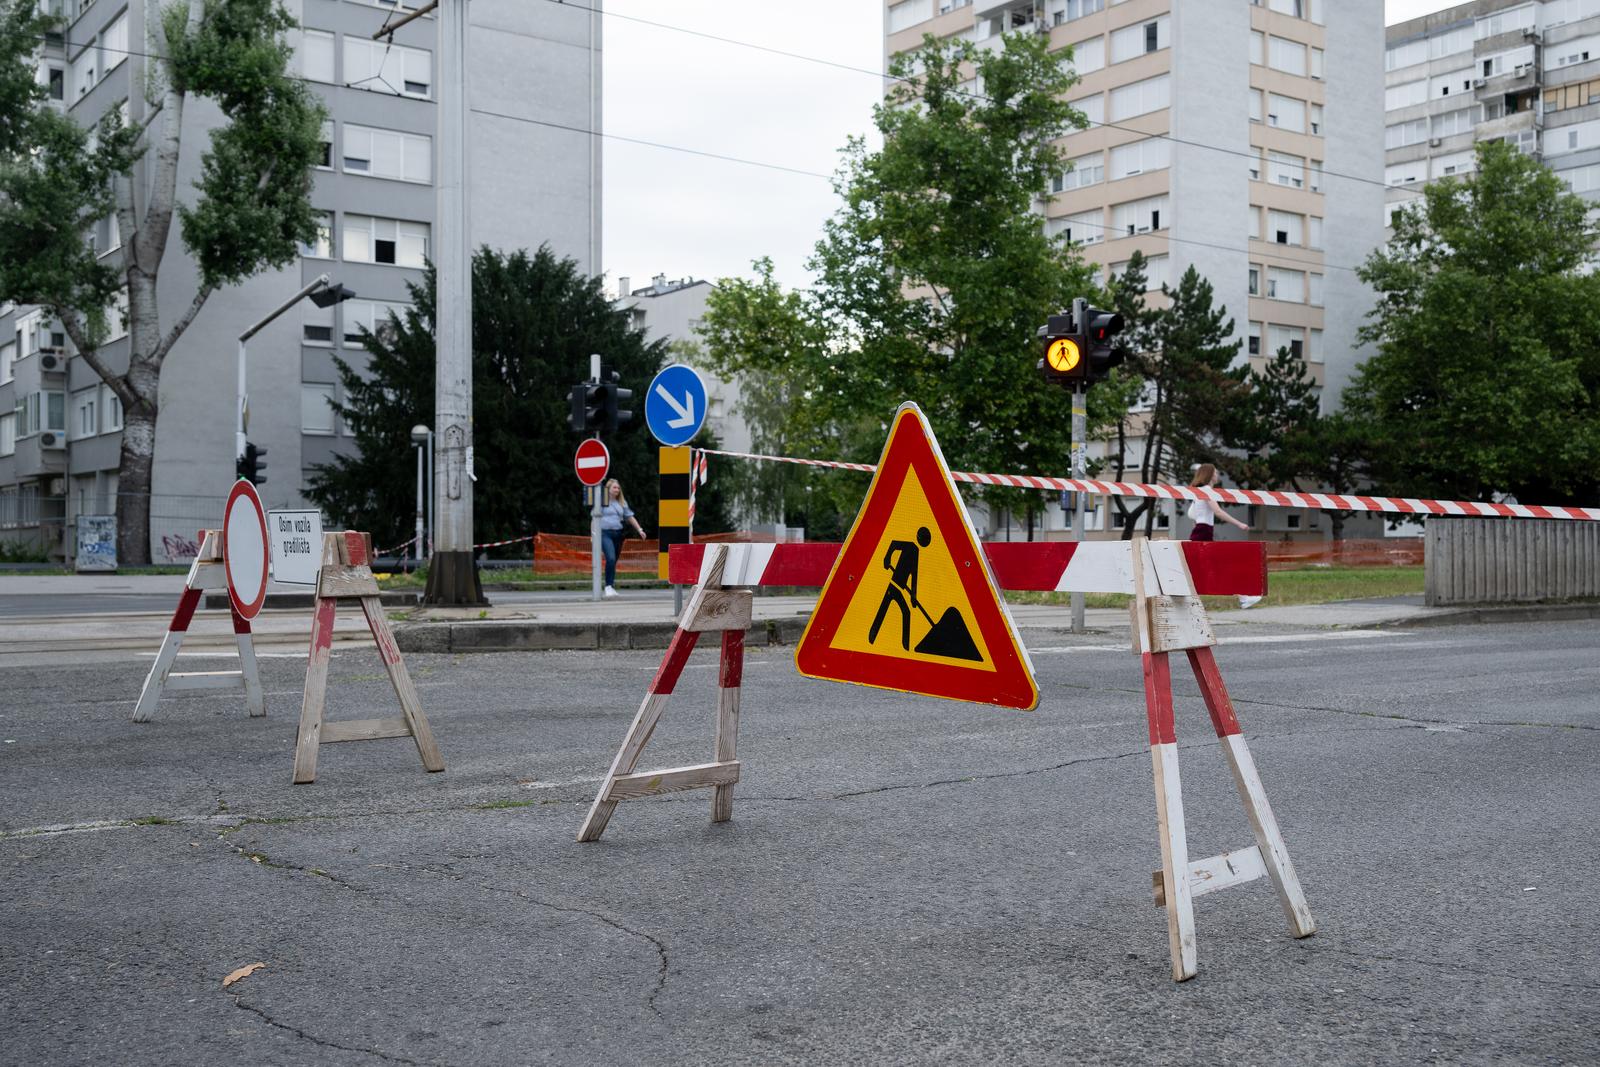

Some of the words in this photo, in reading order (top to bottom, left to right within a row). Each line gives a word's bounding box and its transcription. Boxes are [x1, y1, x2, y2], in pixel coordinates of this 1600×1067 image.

[279, 516, 292, 532] Osim
[294, 516, 310, 533] vozila
[283, 537, 310, 557] gradilišta
